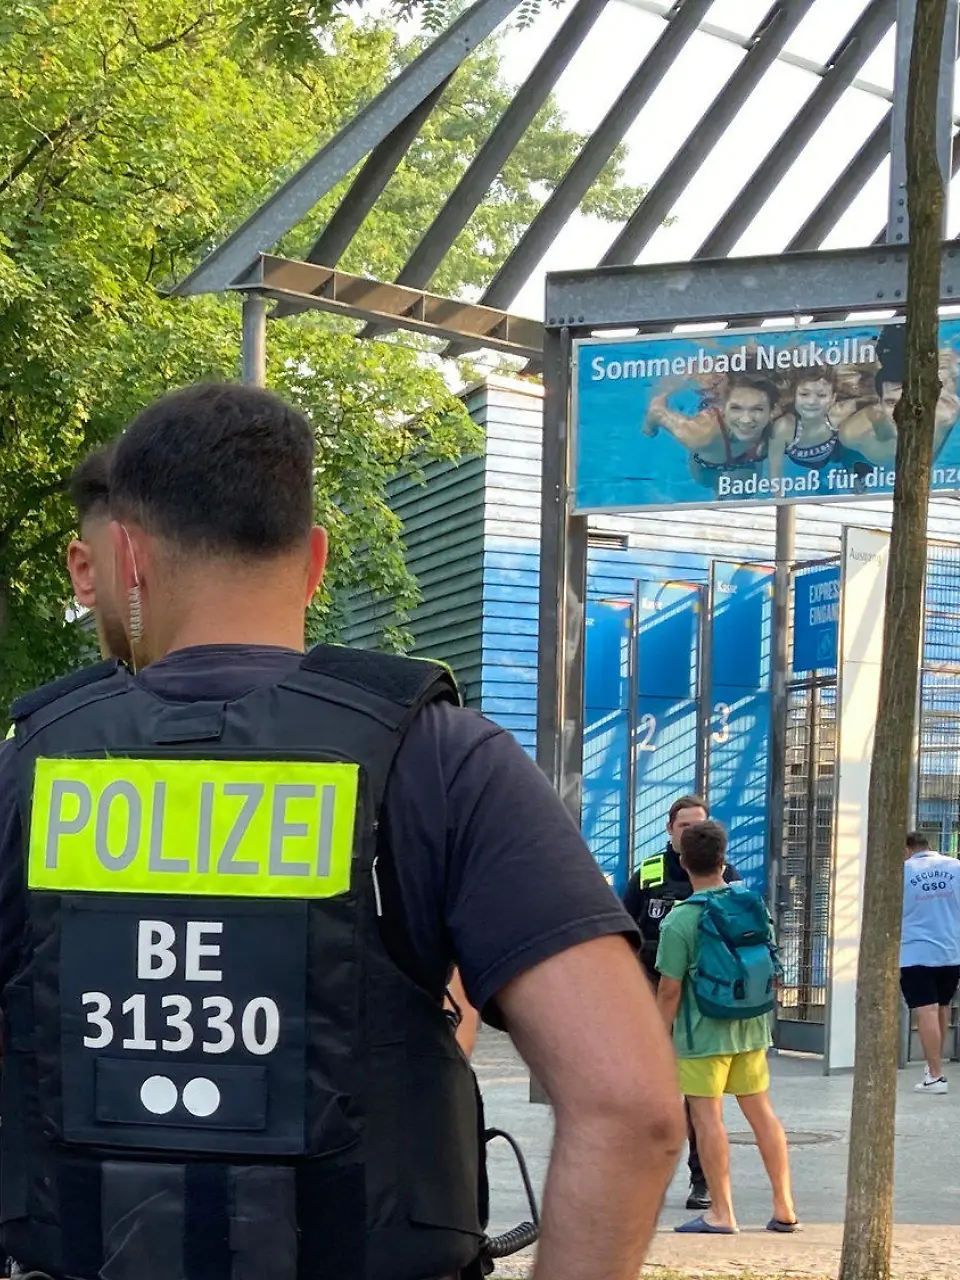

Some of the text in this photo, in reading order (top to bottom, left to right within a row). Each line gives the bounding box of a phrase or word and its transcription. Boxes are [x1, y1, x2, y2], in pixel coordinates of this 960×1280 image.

[591, 337, 876, 382] Sommerbad Neukölln
[718, 466, 896, 497] Badespaß für die
[638, 712, 657, 752] 2
[711, 702, 730, 744] 3
[44, 779, 336, 878] POLIZEI
[910, 870, 955, 887] SECURITY
[922, 881, 946, 892] GSO
[137, 919, 224, 982] BE
[80, 991, 281, 1056] 31330
